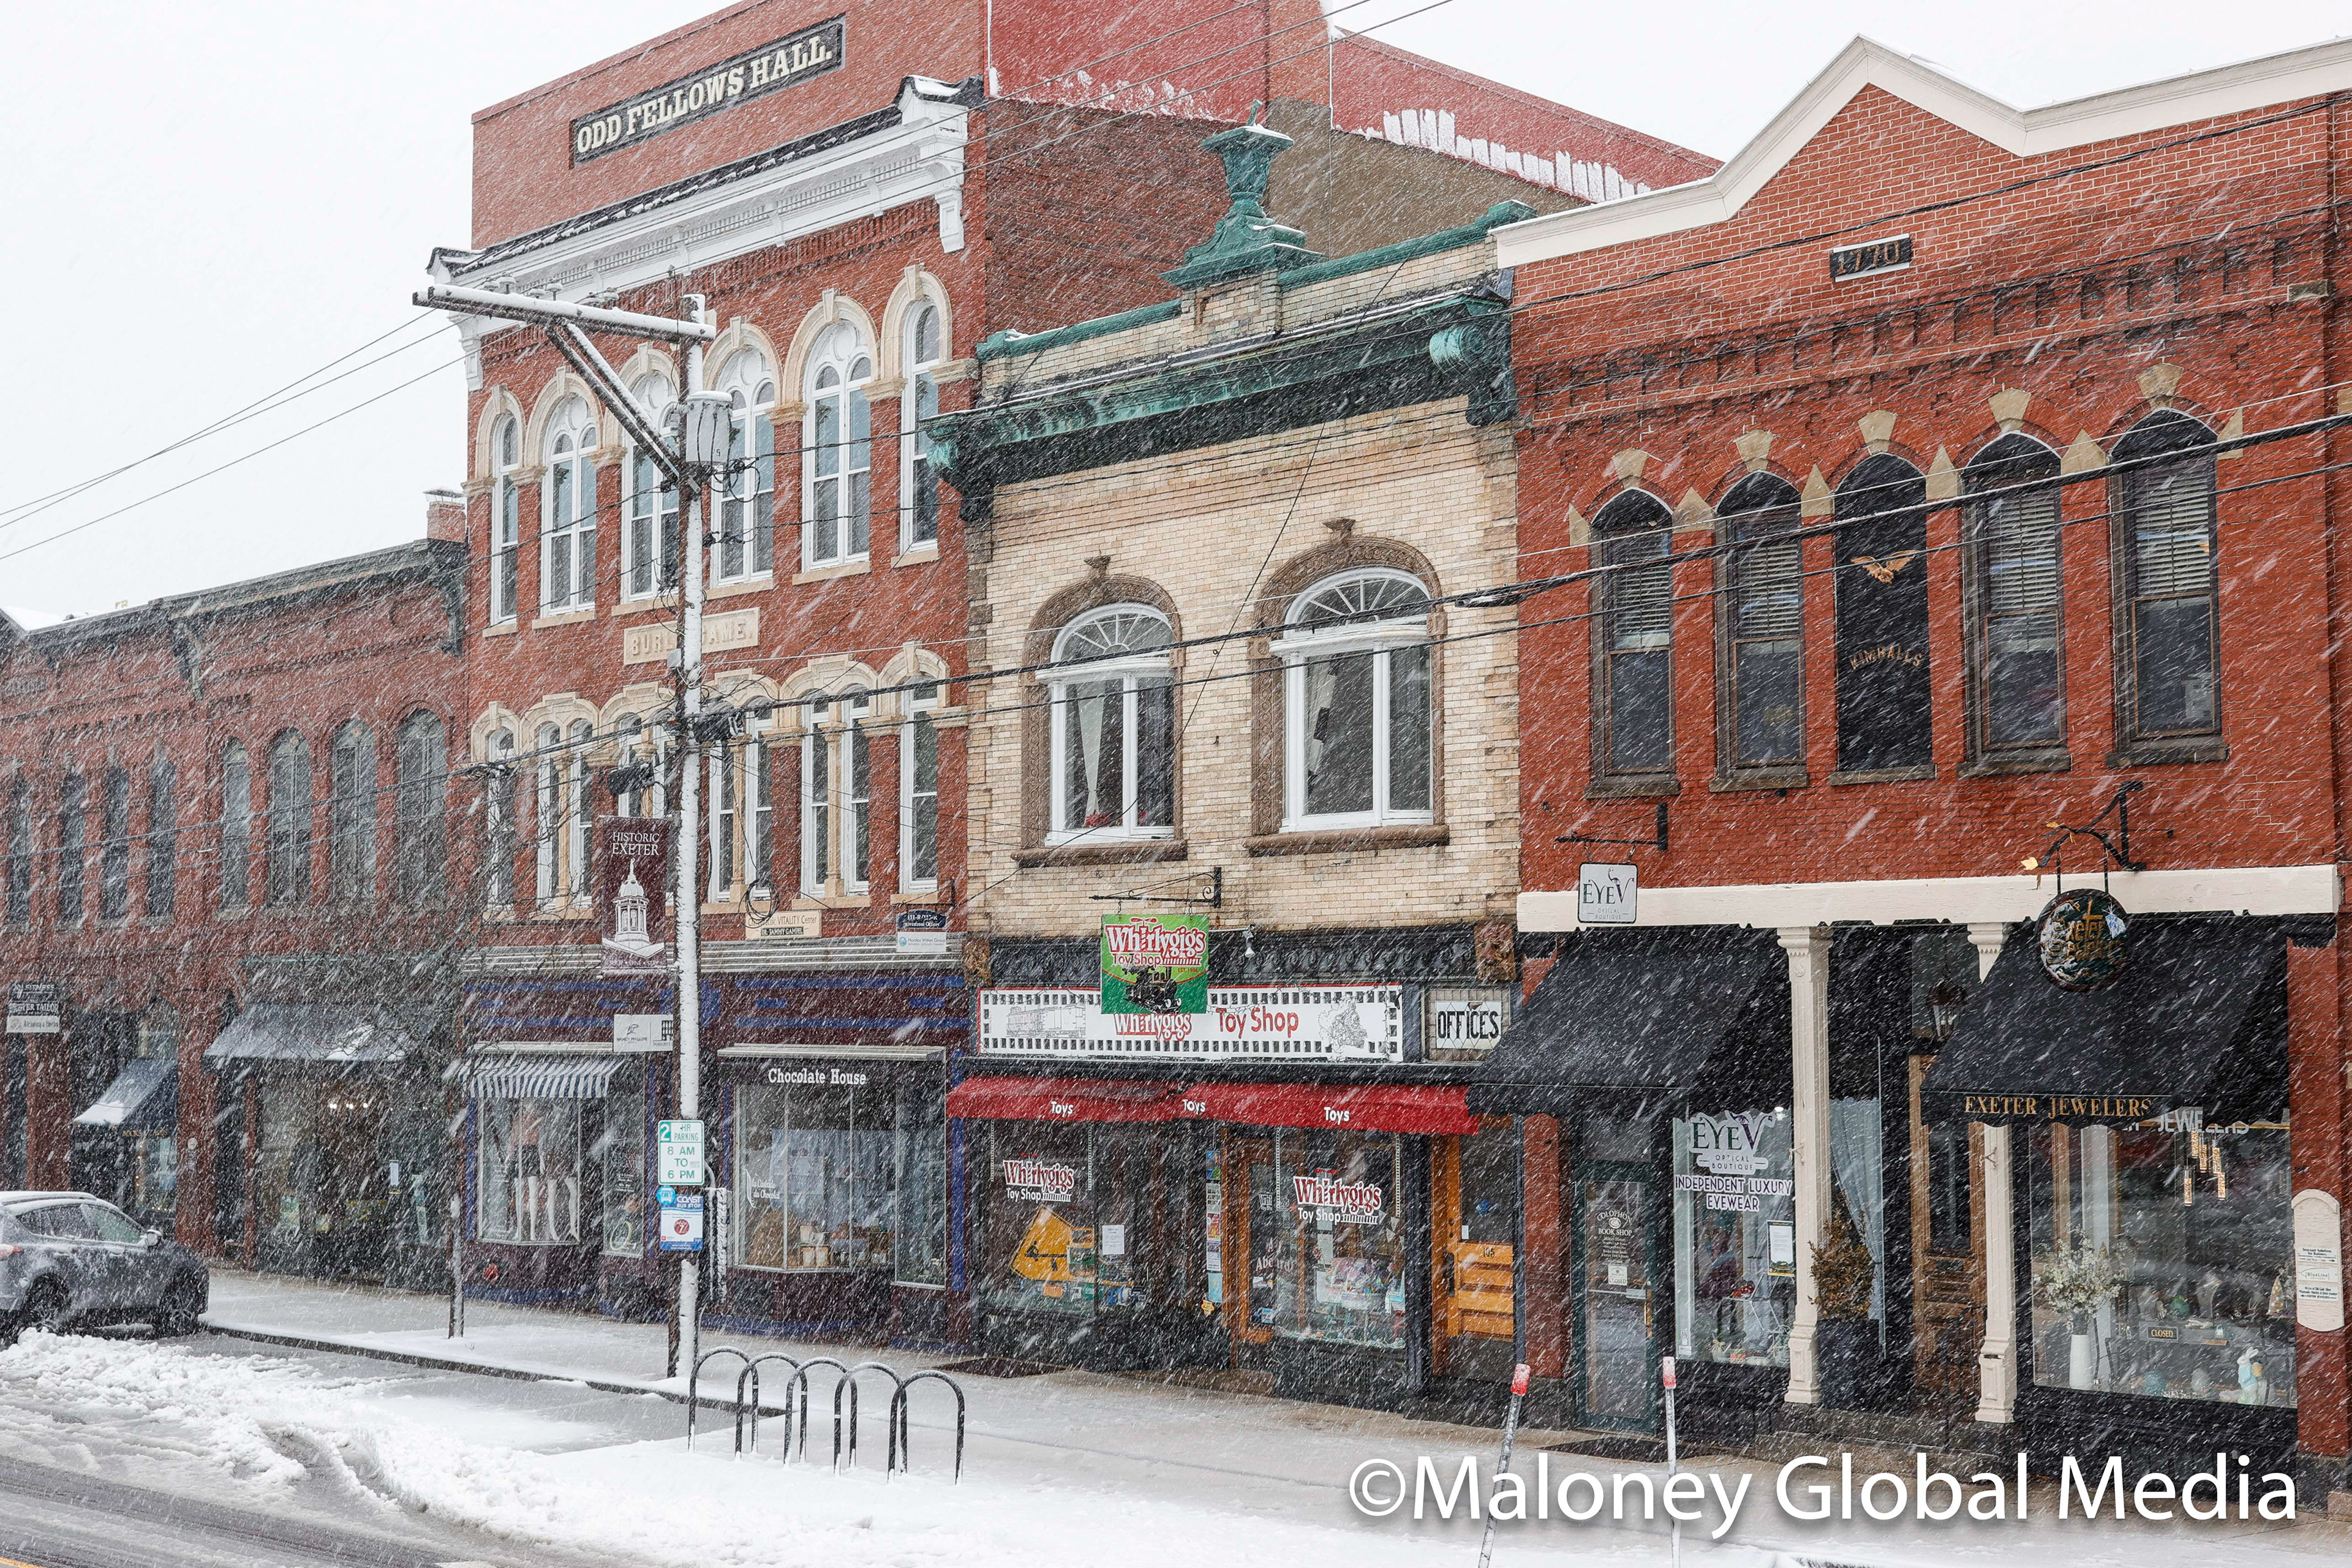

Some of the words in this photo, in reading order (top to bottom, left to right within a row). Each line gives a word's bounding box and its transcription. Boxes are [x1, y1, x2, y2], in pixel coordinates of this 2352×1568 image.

[577, 115, 622, 153] ODD
[625, 65, 744, 136] FELLOWS
[750, 36, 833, 89] HALL.
[1837, 240, 1900, 275] 1770
[1850, 645, 1924, 671] KIMBALLS
[612, 831, 660, 843] HISTORIC
[612, 843, 660, 856] EXETER
[1582, 877, 1635, 905] EYEV
[777, 916, 800, 925] VITALITY
[801, 915, 818, 924] Center
[1106, 924, 1207, 959] Whirlygigs
[1112, 953, 1133, 966] Toy
[1133, 953, 1161, 968] Shop
[37, 1003, 59, 1015] TAILOR
[1113, 1014, 1193, 1042] Whirlygigs
[1215, 1008, 1248, 1039] Toy
[1251, 1006, 1299, 1039] Shop
[1437, 1010, 1499, 1040] OFFICES
[768, 1068, 826, 1084] Chocolate
[830, 1068, 867, 1085] House
[1050, 1101, 1074, 1118] Toys
[1182, 1098, 1206, 1115] Toys
[1964, 1096, 2038, 1115] EXETER
[2048, 1097, 2152, 1119] JEWELERS
[1324, 1106, 1350, 1125] Toys
[660, 1123, 671, 1142] 2
[674, 1133, 699, 1141] PARKING
[1692, 1115, 1773, 1151] EYEV
[667, 1146, 674, 1155] 8
[679, 1146, 695, 1155] AM
[674, 1158, 688, 1167] TO
[668, 1170, 674, 1179] 6
[680, 1170, 695, 1179] PM
[1003, 1159, 1074, 1194] Whirlygigs
[1675, 1175, 1745, 1194] INDEPENDENT
[1749, 1178, 1792, 1195] LUXURY
[1006, 1188, 1020, 1202] Toy
[1021, 1188, 1041, 1204] Shop
[1293, 1175, 1382, 1215] Whirlygigs
[1706, 1194, 1760, 1212] EYEWEAR
[1297, 1207, 1314, 1224] Toy
[1316, 1208, 1341, 1225] Shop
[1597, 1210, 1632, 1224] COLOPHON
[679, 1224, 685, 1233] 7
[1598, 1227, 1615, 1236] BOOK
[2150, 1329, 2174, 1339] CLOSED
